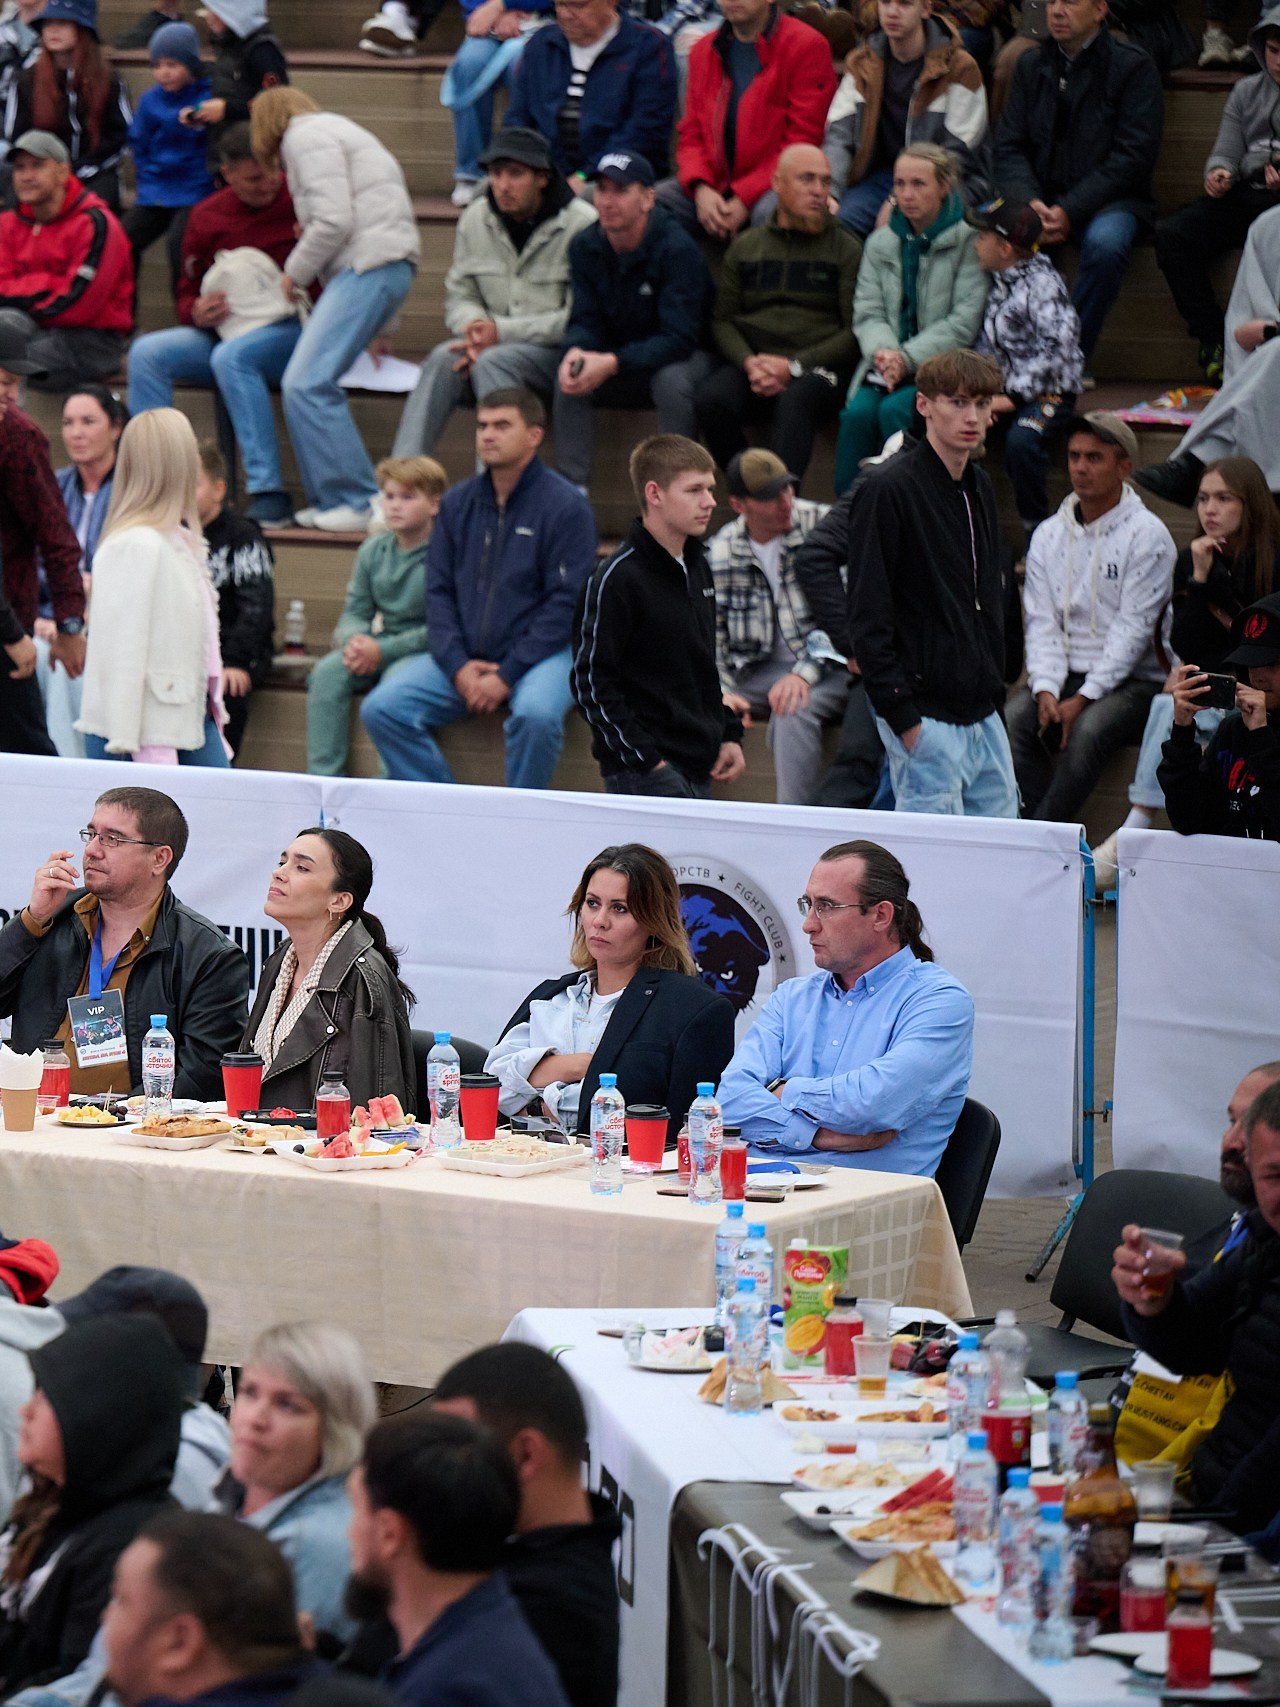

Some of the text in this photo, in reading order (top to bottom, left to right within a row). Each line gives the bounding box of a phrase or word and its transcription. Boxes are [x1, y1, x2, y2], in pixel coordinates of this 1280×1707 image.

[733, 881, 784, 950] FIGHT CLUB
[87, 1005, 106, 1017] VIP
